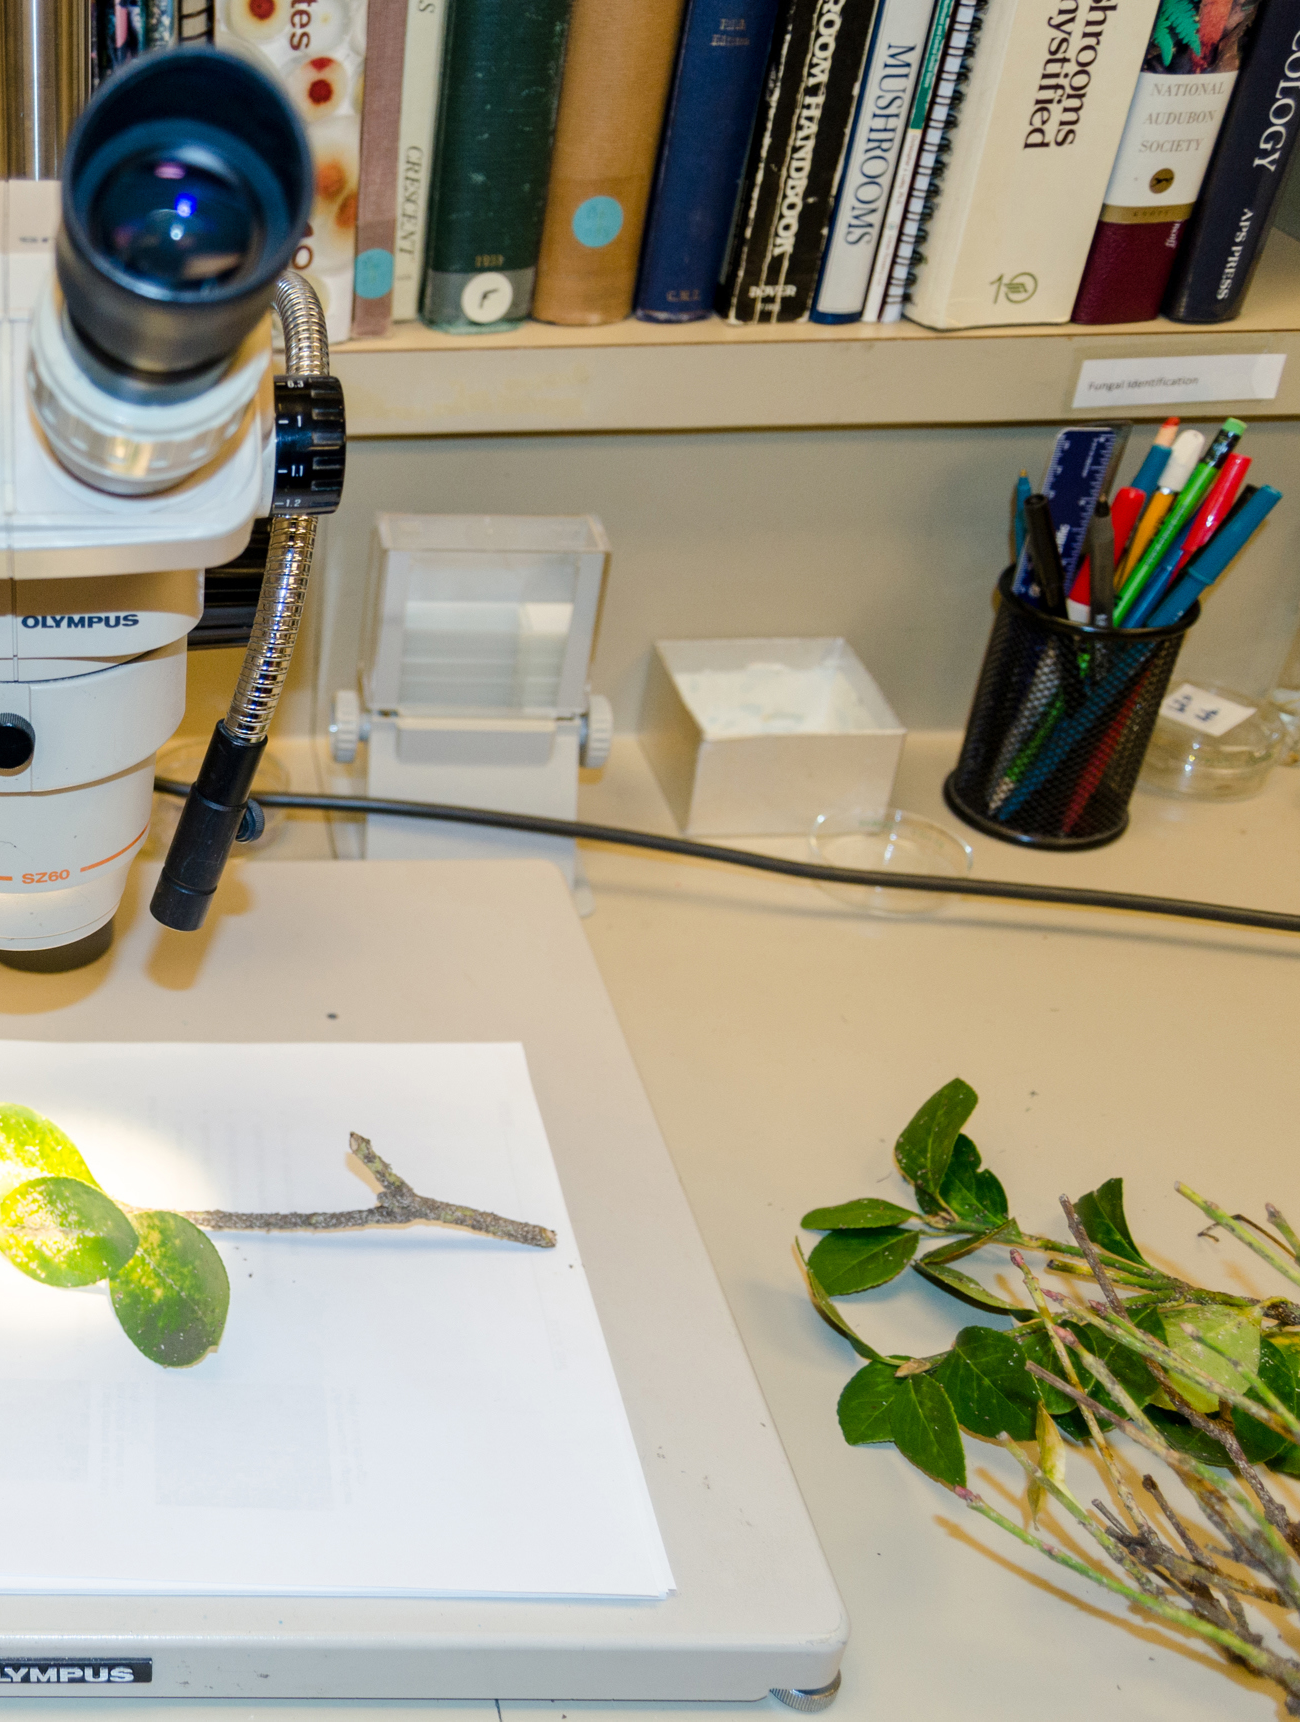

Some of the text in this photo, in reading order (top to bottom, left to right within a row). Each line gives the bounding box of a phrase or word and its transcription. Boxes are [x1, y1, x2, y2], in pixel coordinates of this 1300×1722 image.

[1054, 0, 1118, 147] hrooms
[1151, 81, 1226, 97] NATIONAL
[1142, 110, 1218, 126] AUDUBON
[844, 42, 917, 247] MUSHROOMS
[1138, 138, 1205, 153] SOCIETY
[772, 95, 826, 258] HANDBOOK
[398, 145, 424, 262] CRESCENT
[1216, 208, 1254, 300] APS PRESS
[749, 284, 797, 299] DOVER
[1088, 380, 1125, 392] Fungal
[291, 464, 304, 478] 1.1
[285, 498, 301, 508] 1.2
[21, 613, 140, 630] OLYMPUS
[21, 869, 71, 885] SZ60
